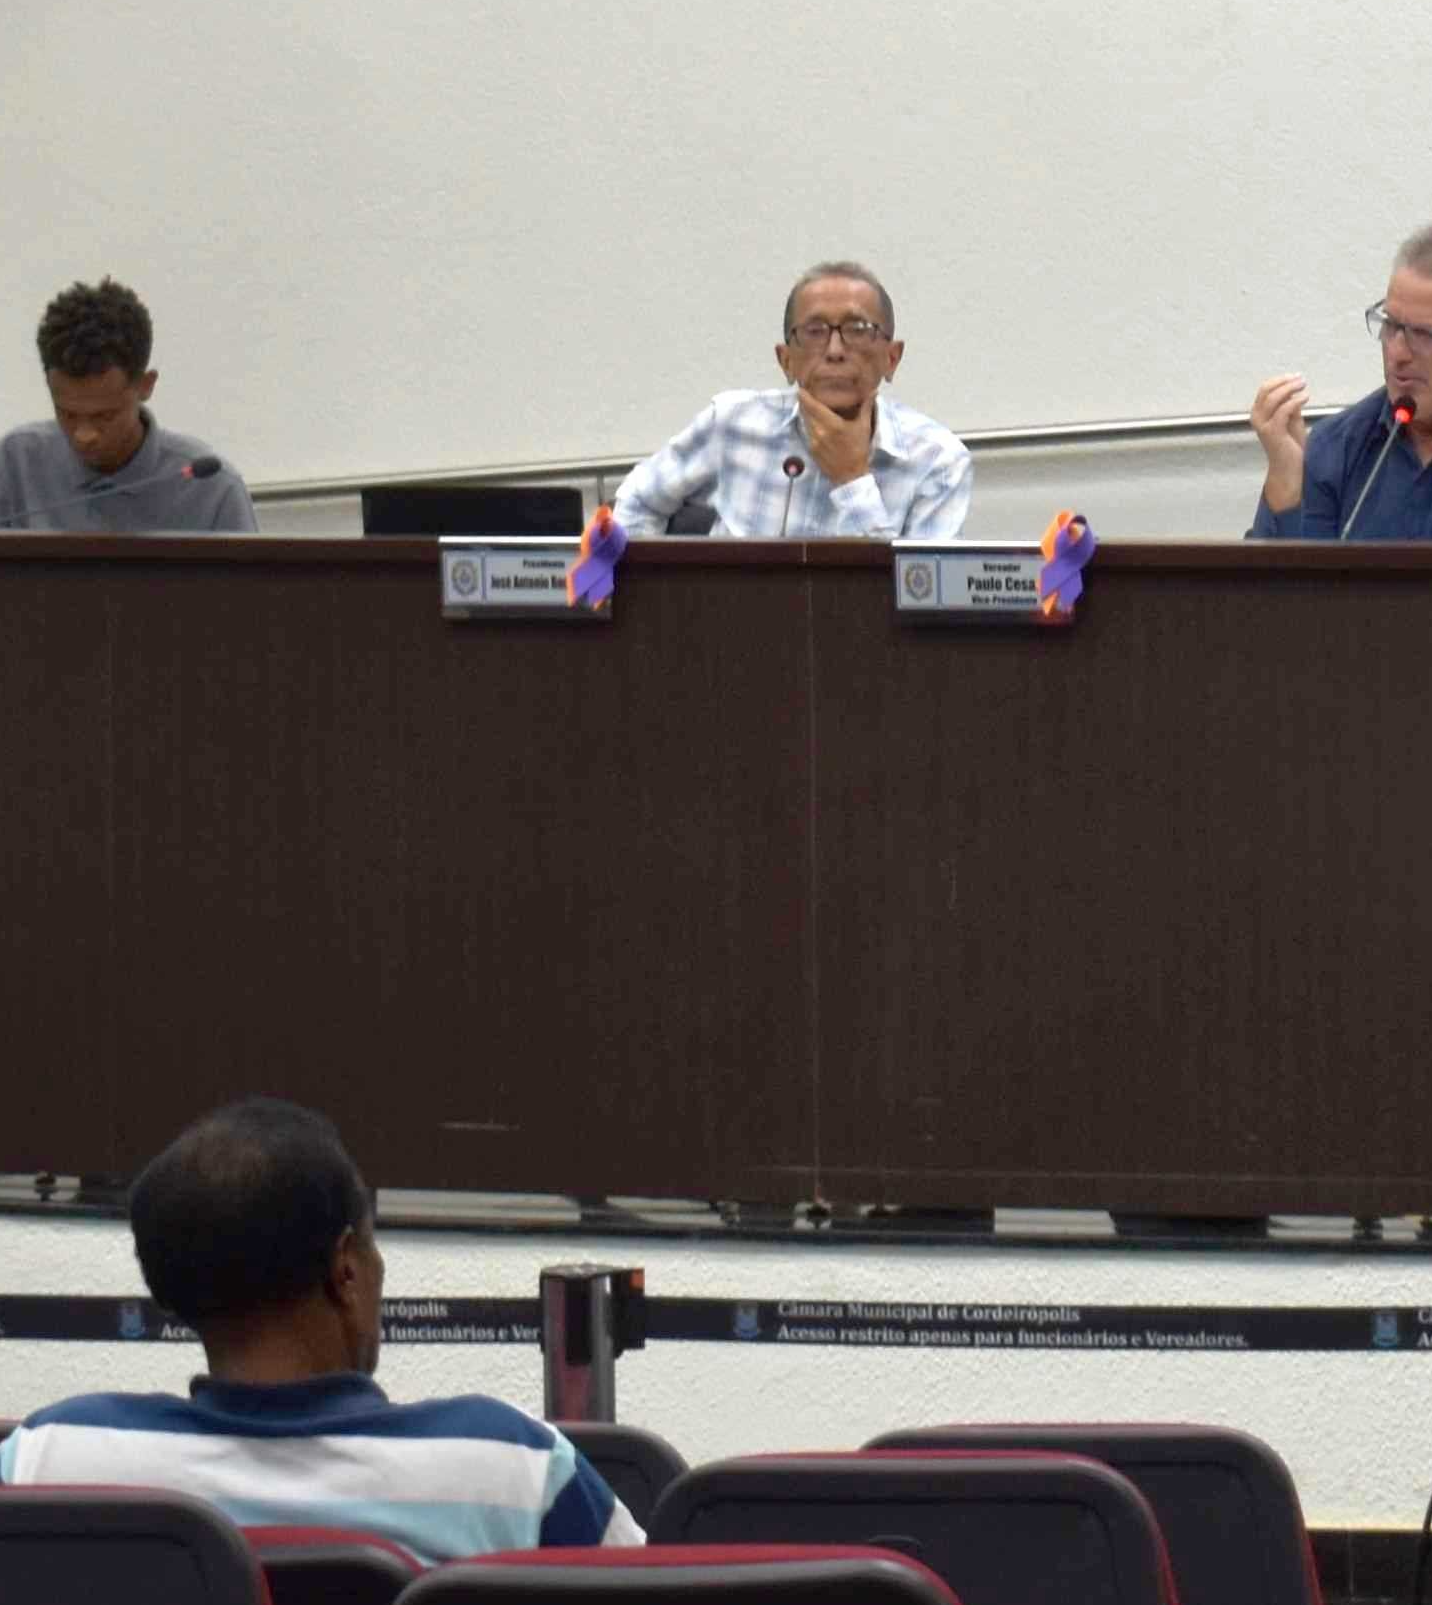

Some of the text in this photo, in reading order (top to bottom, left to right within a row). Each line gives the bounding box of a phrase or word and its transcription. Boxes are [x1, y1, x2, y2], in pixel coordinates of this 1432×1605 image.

[967, 576, 1036, 591] Paulo Cesa
[777, 1301, 1081, 1326] Câmara Municipal de Cordeirópolis
[390, 1324, 497, 1342] funcionários
[499, 1330, 508, 1340] e
[777, 1323, 836, 1341] Acesso
[840, 1324, 906, 1343] restrito
[908, 1328, 971, 1346] apenas
[974, 1330, 1014, 1348] para
[1017, 1326, 1128, 1348] funcionários
[1131, 1333, 1141, 1347] e
